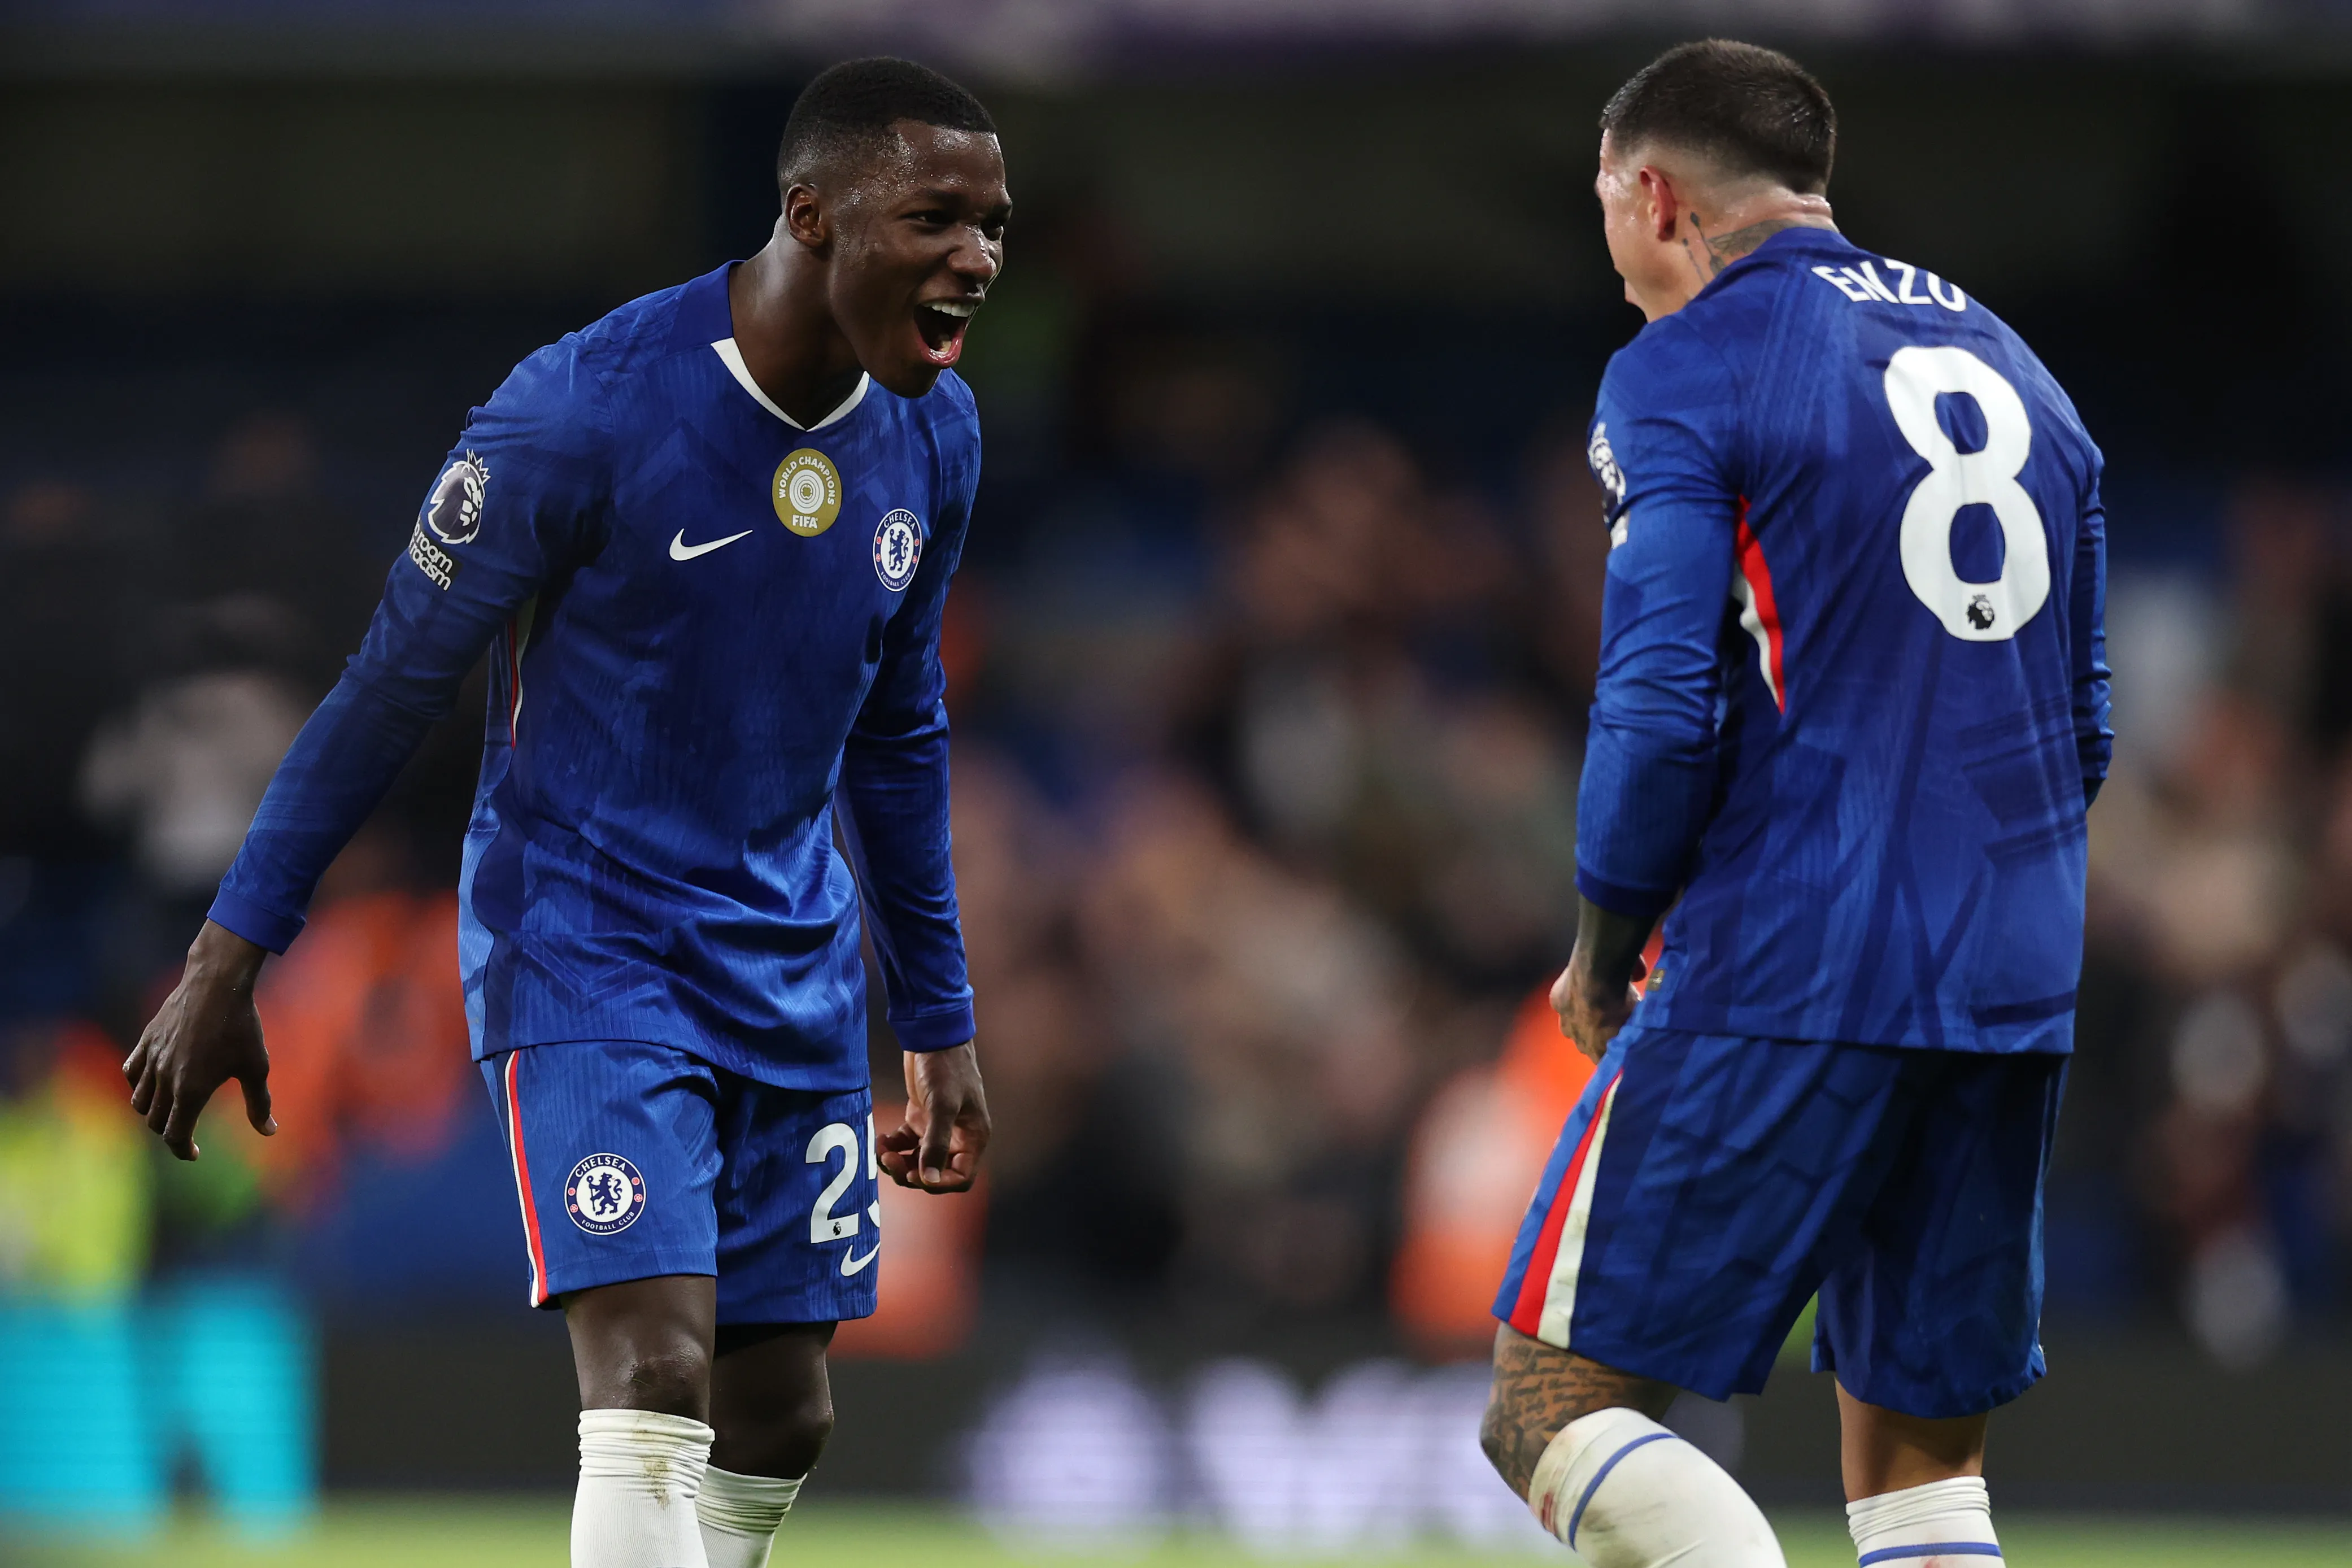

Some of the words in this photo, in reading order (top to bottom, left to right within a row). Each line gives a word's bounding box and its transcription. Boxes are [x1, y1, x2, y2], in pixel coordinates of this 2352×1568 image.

[1811, 258, 1966, 312] ENZO
[779, 461, 797, 499] WORLD
[799, 456, 835, 505] CHAMPIONS
[1883, 346, 2050, 642] 8
[792, 515, 818, 529] FIFA
[883, 512, 916, 530] CHELSEA
[410, 543, 451, 591] racism
[416, 532, 453, 573] room
[881, 571, 899, 587] FOOTBALL
[900, 572, 911, 585] CLUB
[575, 1156, 626, 1177] CHELSEA
[582, 1219, 616, 1230] FOOTBALL
[619, 1211, 634, 1225] CLUB
